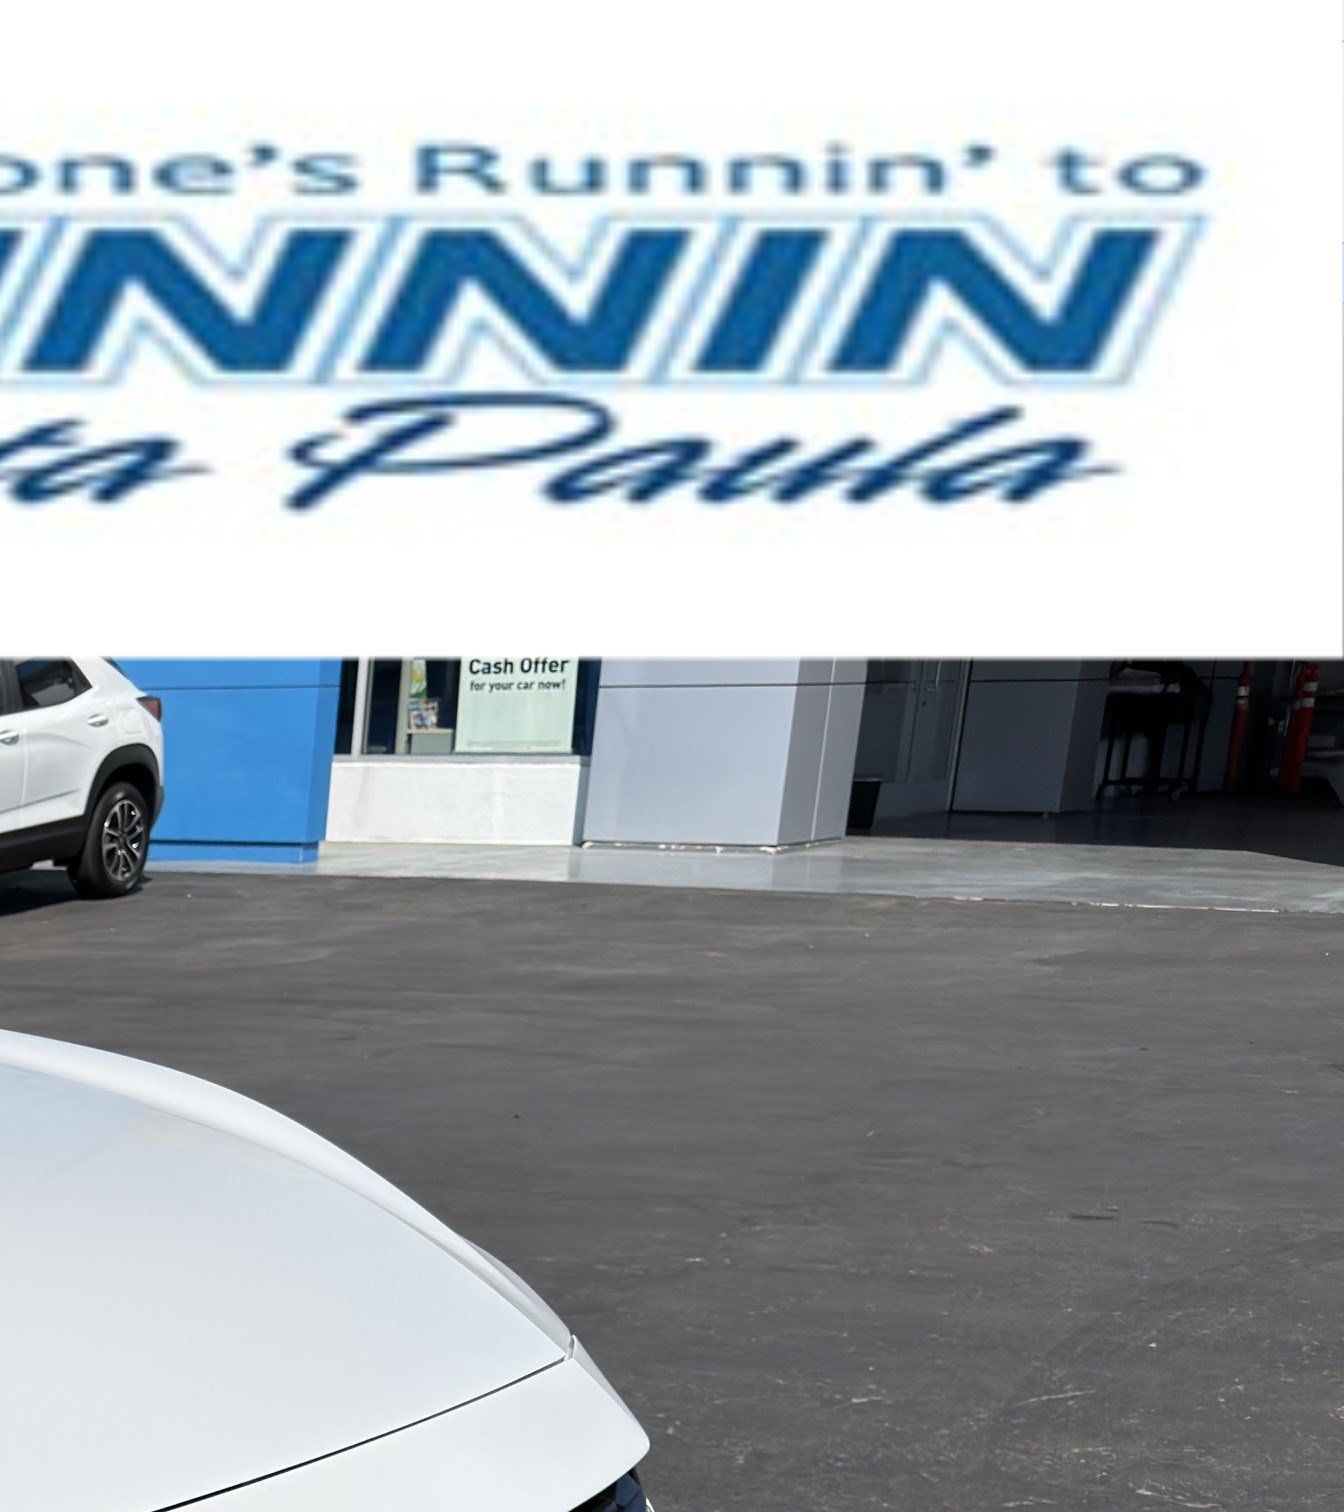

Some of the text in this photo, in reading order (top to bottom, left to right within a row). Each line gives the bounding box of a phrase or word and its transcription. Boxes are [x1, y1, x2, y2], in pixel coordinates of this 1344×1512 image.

[469, 657, 569, 675] Cash Offer
[470, 679, 566, 693] for your car now!
